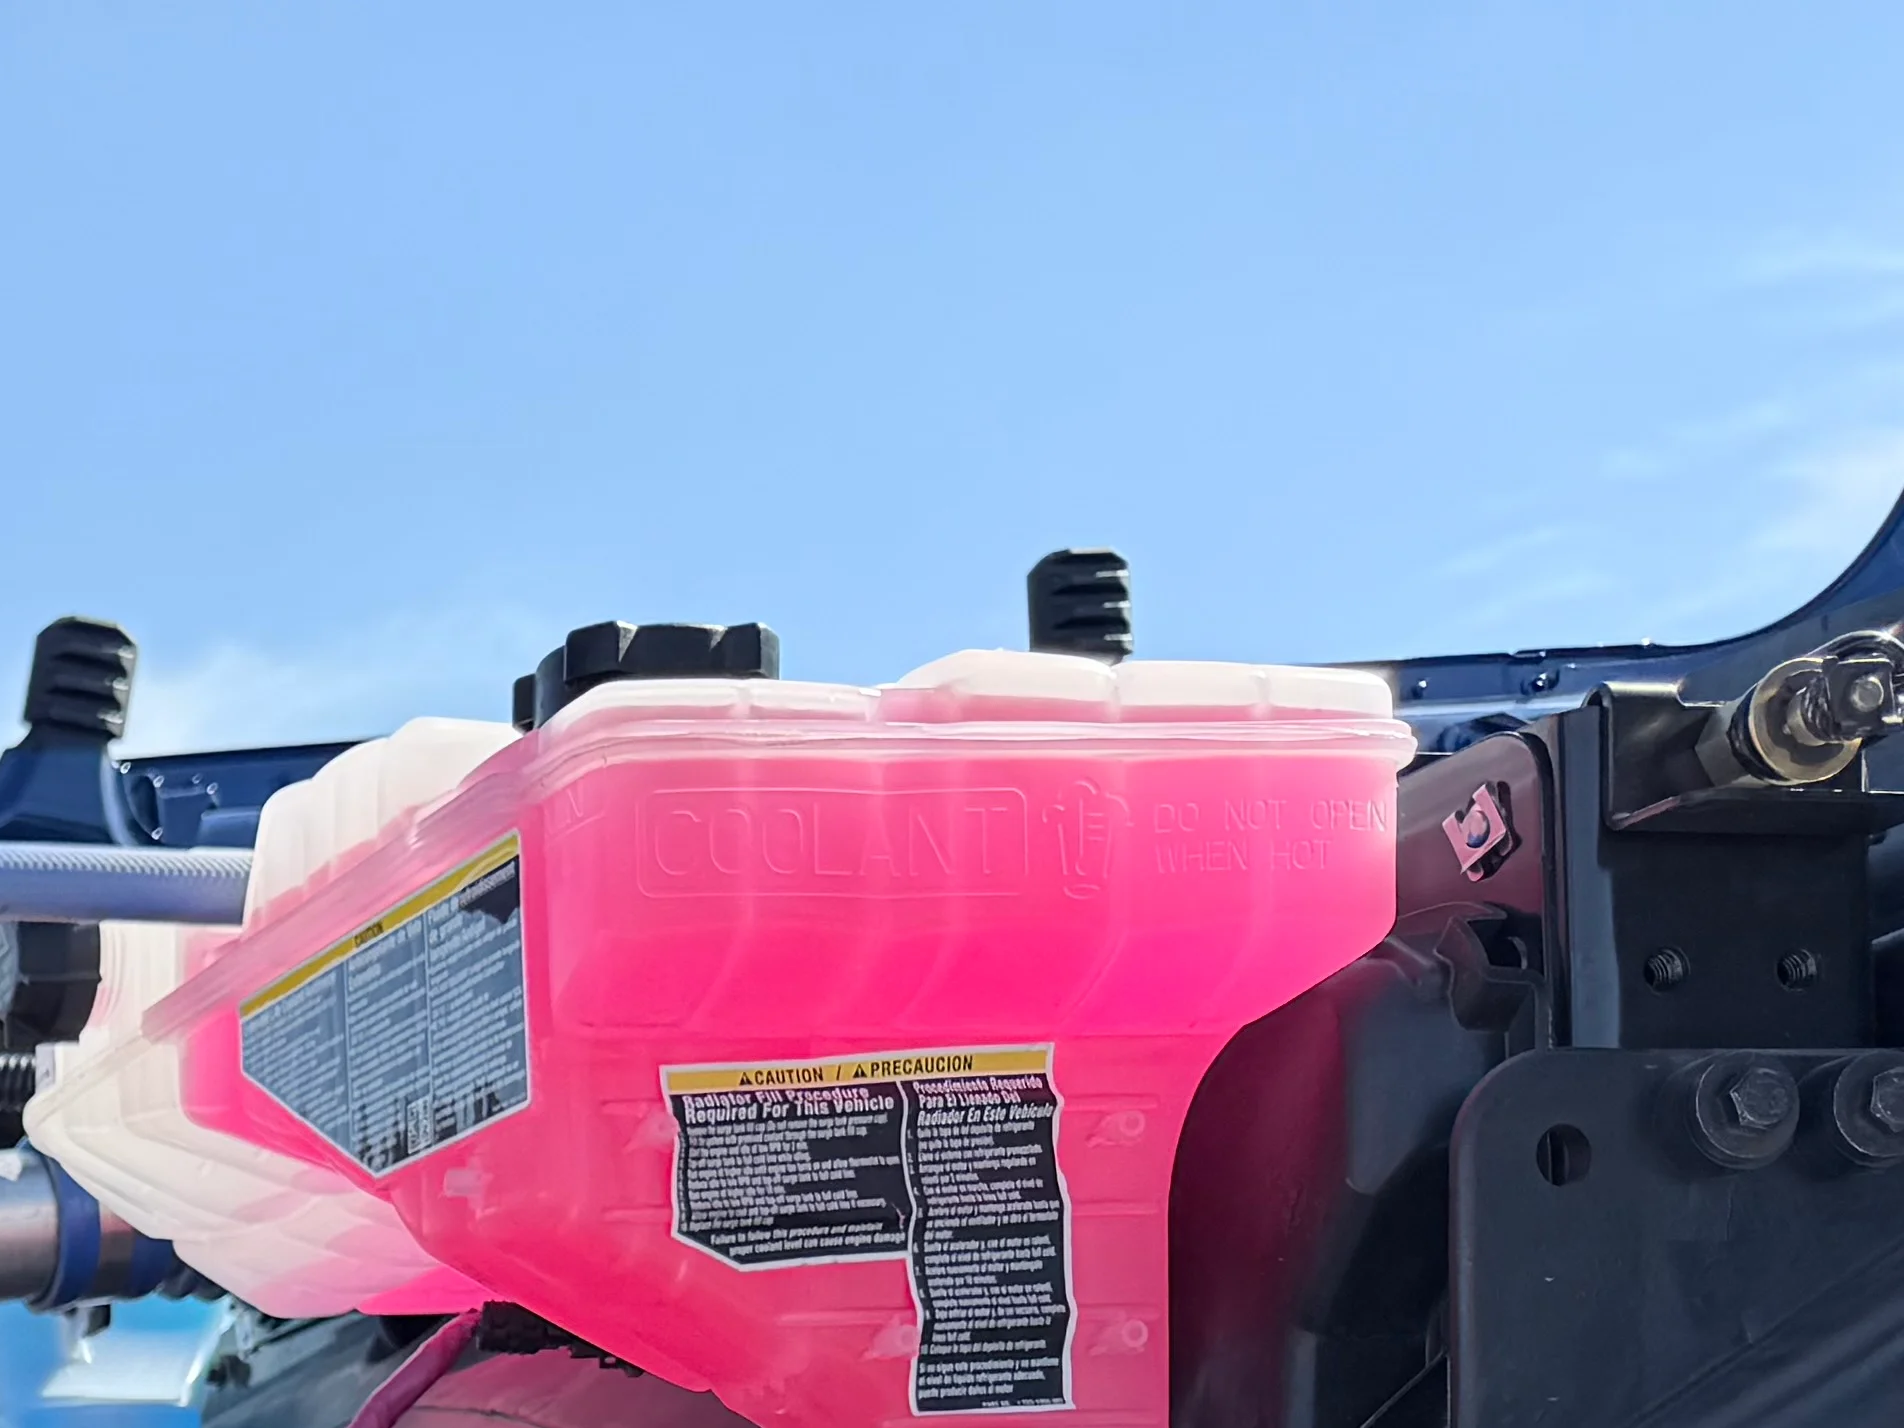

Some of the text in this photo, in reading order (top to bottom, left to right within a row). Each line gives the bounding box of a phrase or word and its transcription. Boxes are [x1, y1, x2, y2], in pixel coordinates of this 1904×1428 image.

[1228, 801, 1284, 830] NOT
[1310, 799, 1387, 830] OPEN
[653, 806, 1009, 877] COOLANT
[1154, 840, 1329, 873] WHEN HOT
[755, 1068, 823, 1085] CAUTION
[871, 1056, 973, 1077] PRECAUCION
[685, 1094, 894, 1124] Required For This Vehicle
